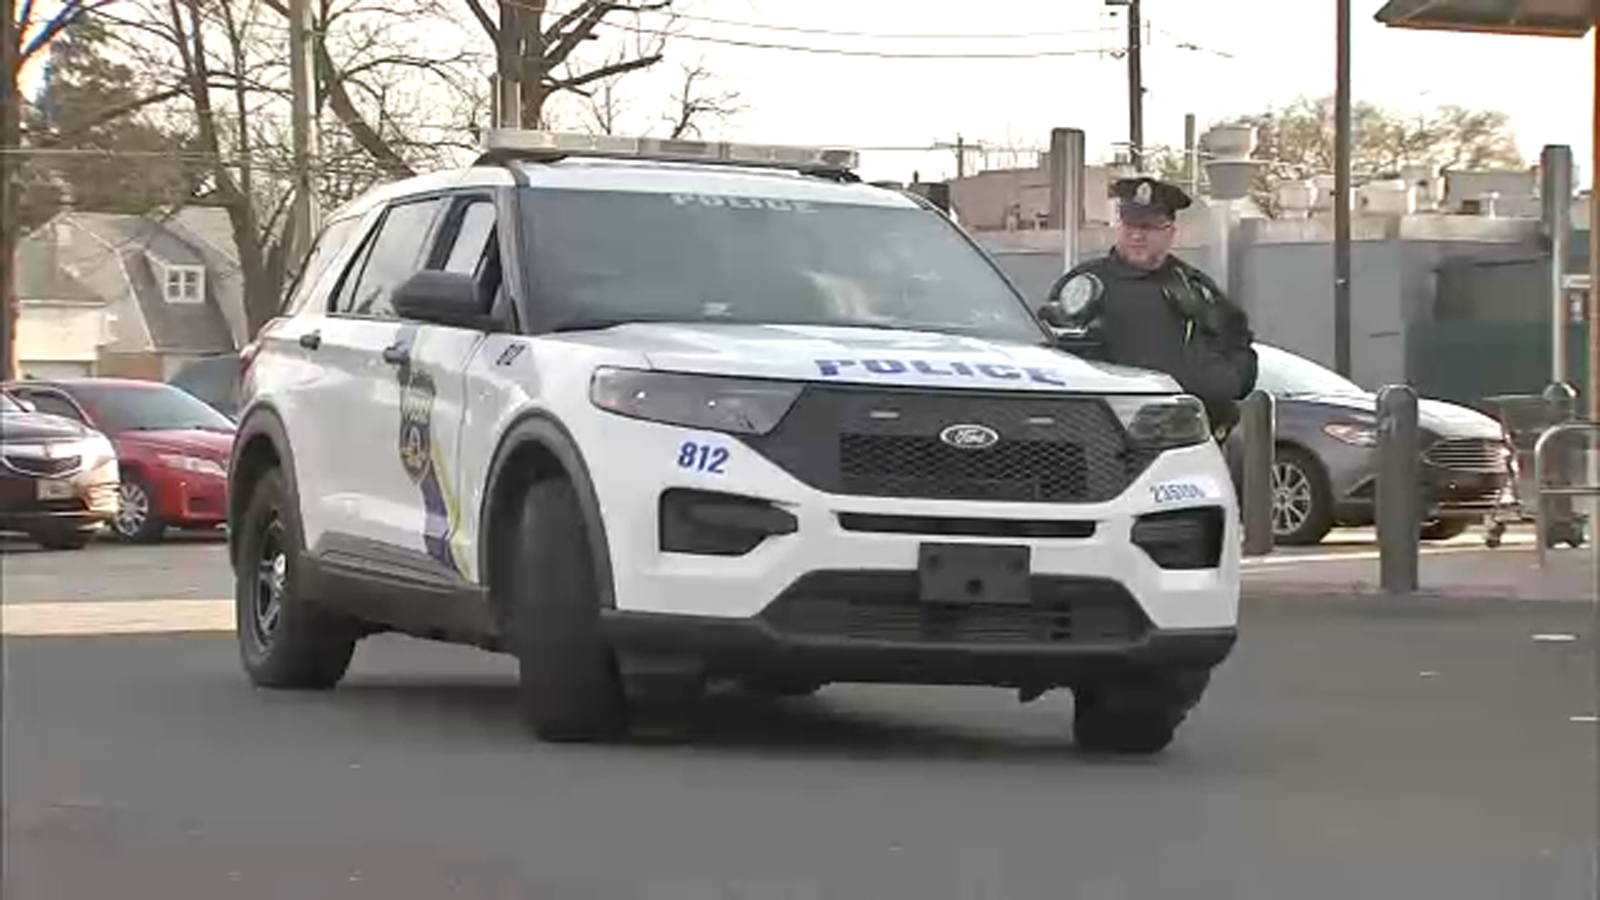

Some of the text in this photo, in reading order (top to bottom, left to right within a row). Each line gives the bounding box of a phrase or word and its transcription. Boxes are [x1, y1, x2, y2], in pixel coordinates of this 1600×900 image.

[670, 192, 820, 214] POLICE
[814, 359, 1067, 387] POLICE
[678, 441, 729, 475] 812
